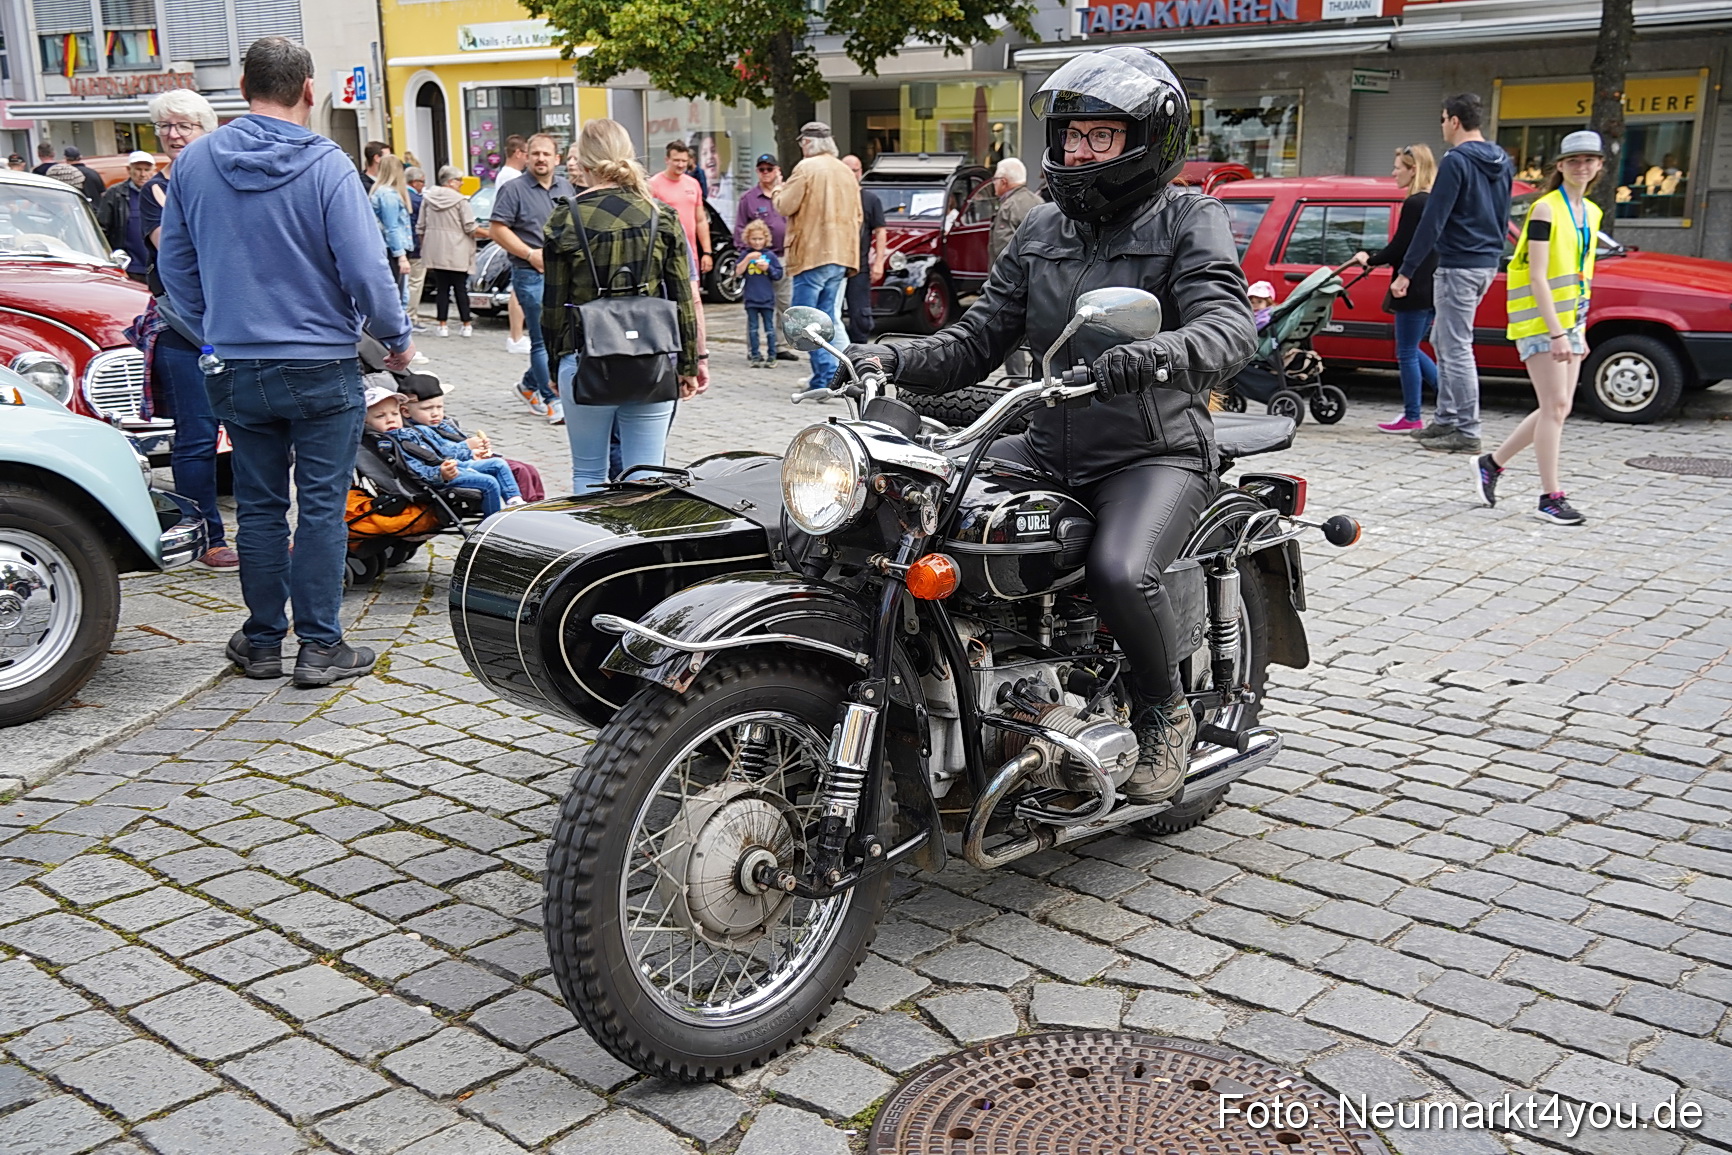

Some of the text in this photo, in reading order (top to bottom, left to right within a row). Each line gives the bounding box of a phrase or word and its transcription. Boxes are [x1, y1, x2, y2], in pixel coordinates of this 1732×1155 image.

[1328, 0, 1372, 12] THUMANN
[1075, 0, 1298, 34] TABAKWAREN
[479, 36, 499, 47] Nails
[355, 70, 364, 97] P
[1576, 94, 1695, 115] SLIERF
[545, 113, 571, 127] NAILS
[1027, 514, 1051, 531] URAL
[880, 1074, 932, 1134] PASSAVANT
